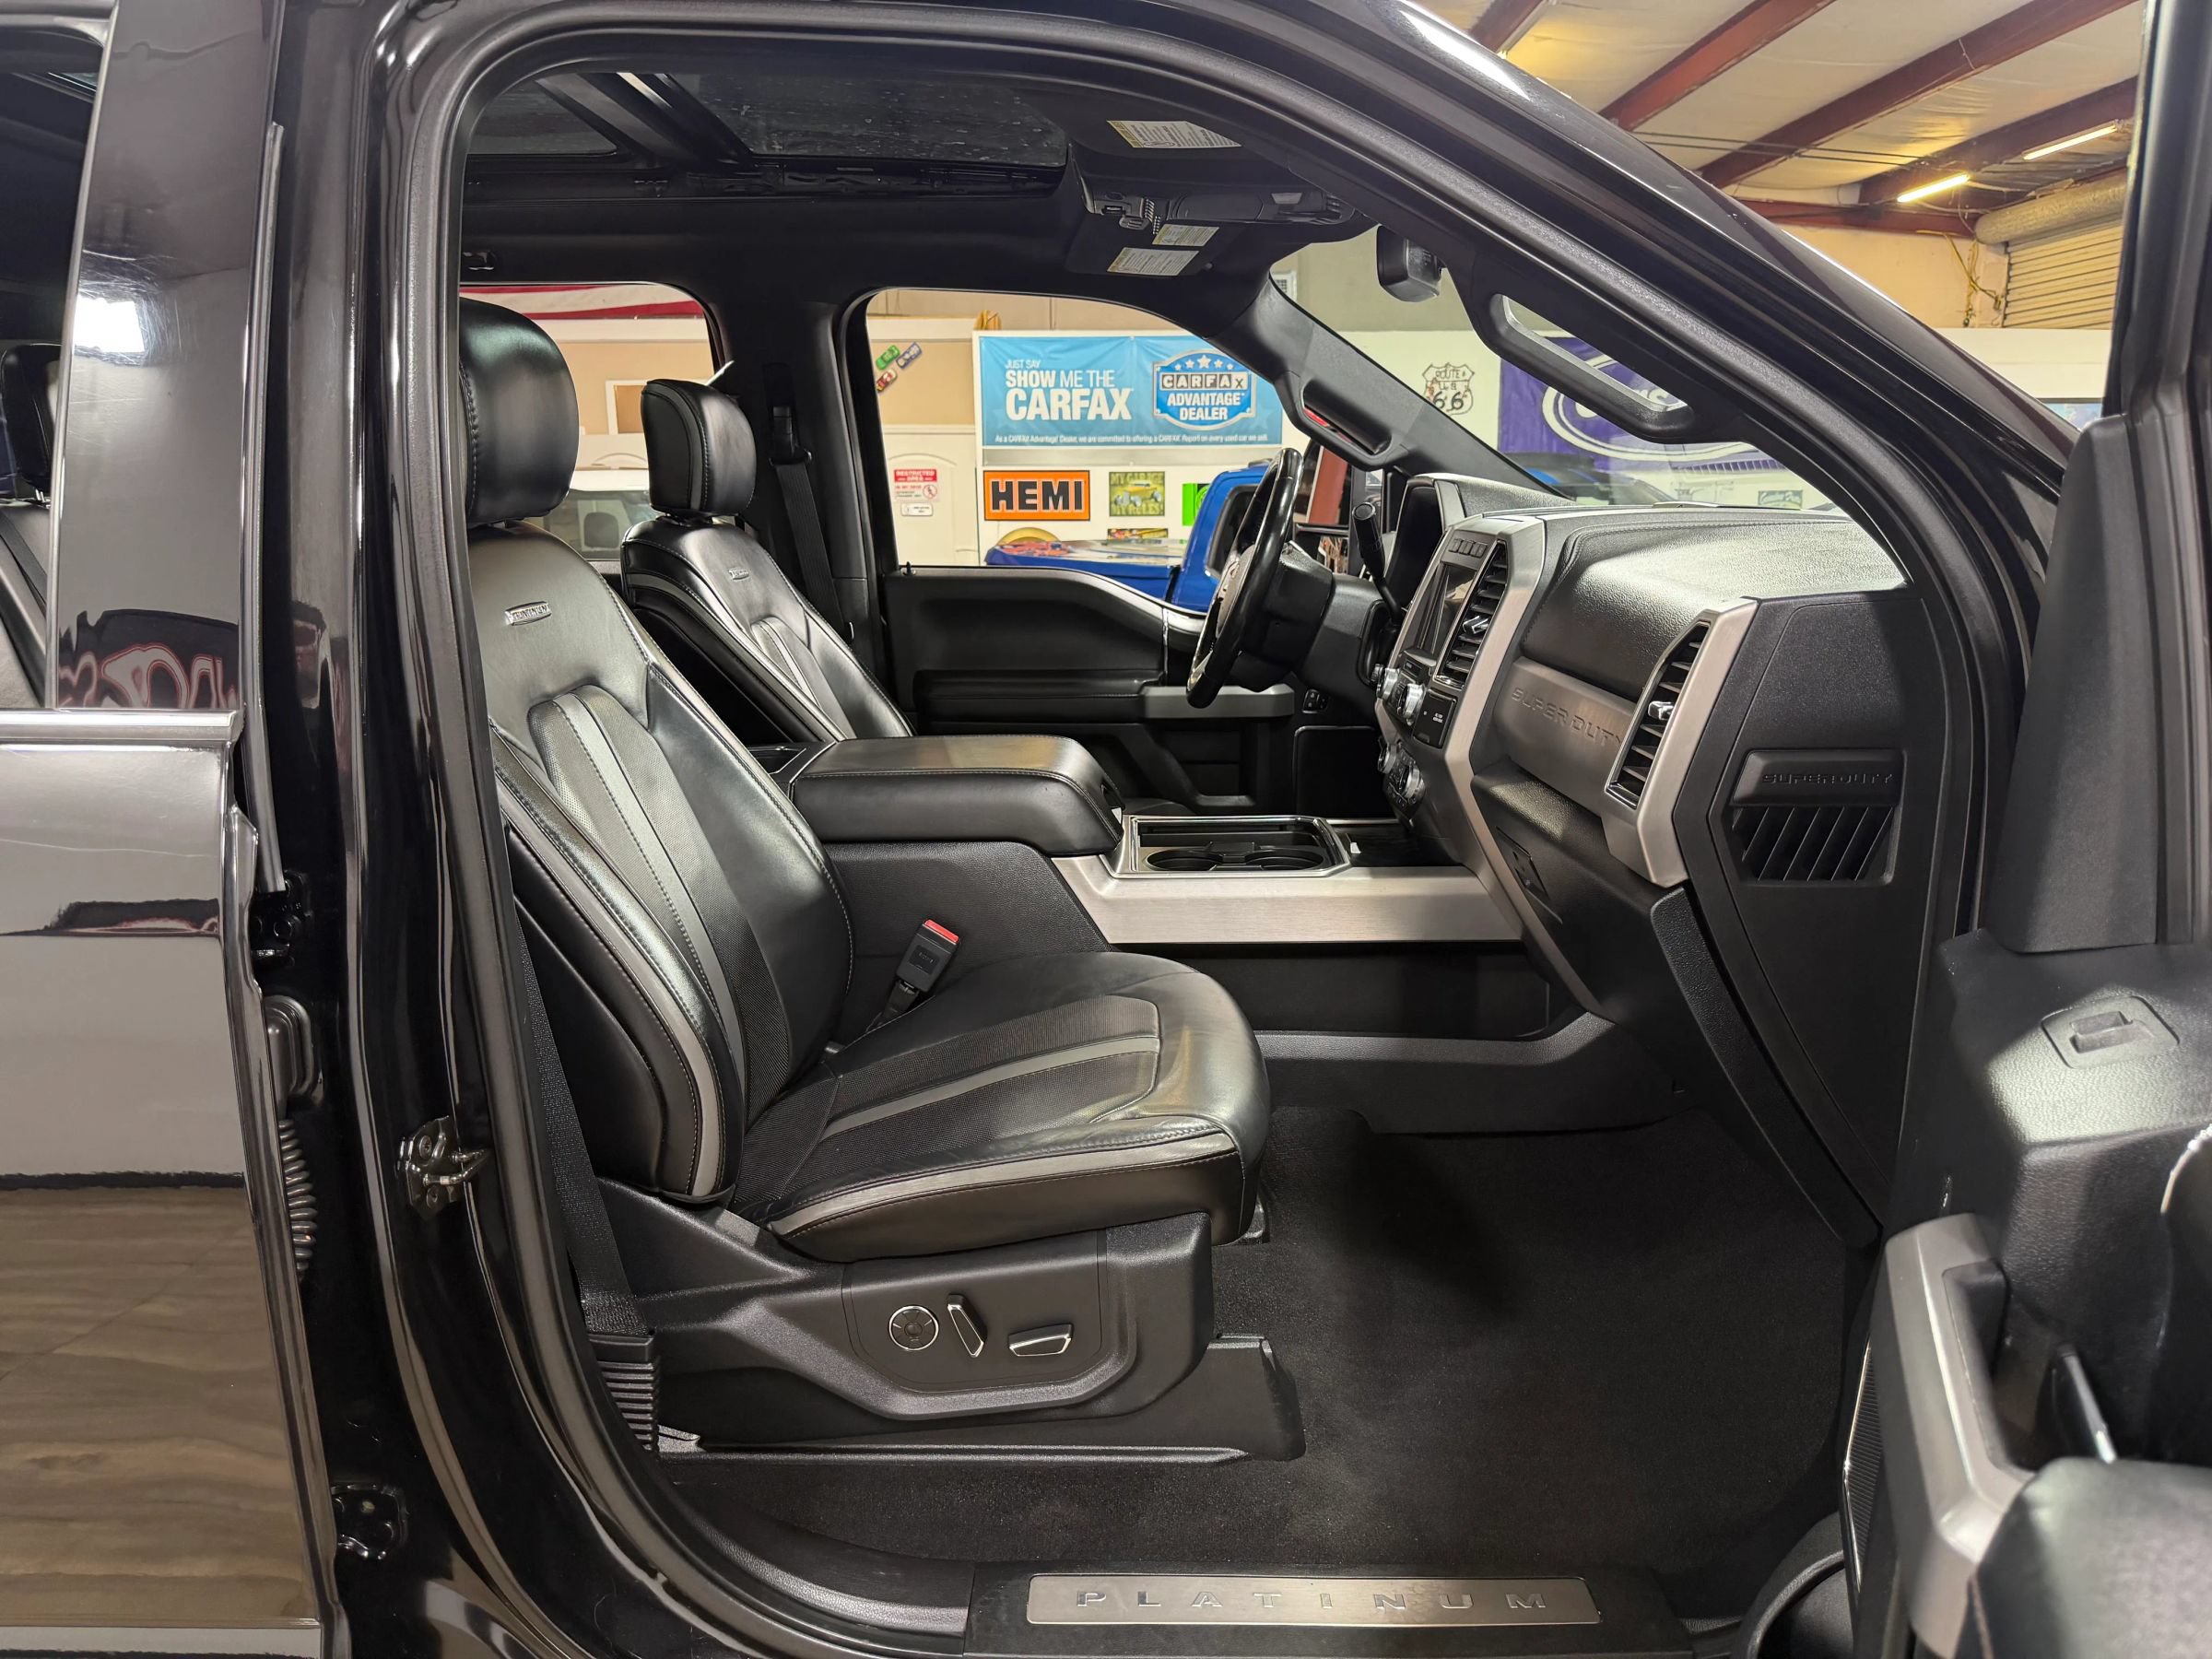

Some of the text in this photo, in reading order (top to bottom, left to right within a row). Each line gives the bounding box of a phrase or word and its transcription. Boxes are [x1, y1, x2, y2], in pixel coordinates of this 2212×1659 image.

[1006, 360, 1041, 369] JUST SAY
[1006, 371, 1115, 388] SHOW ME THE
[1161, 373, 1245, 390] CARFAX
[1435, 370, 1461, 379] ROUTE
[1006, 388, 1133, 420] CARFAX
[1167, 392, 1241, 406] ADVANTAGE
[1433, 391, 1464, 411] 66
[1180, 407, 1229, 421] DEALER
[991, 480, 1083, 511] HEMI
[1512, 688, 1569, 727] SUPER
[1077, 1591, 1547, 1609] PLATINUM
